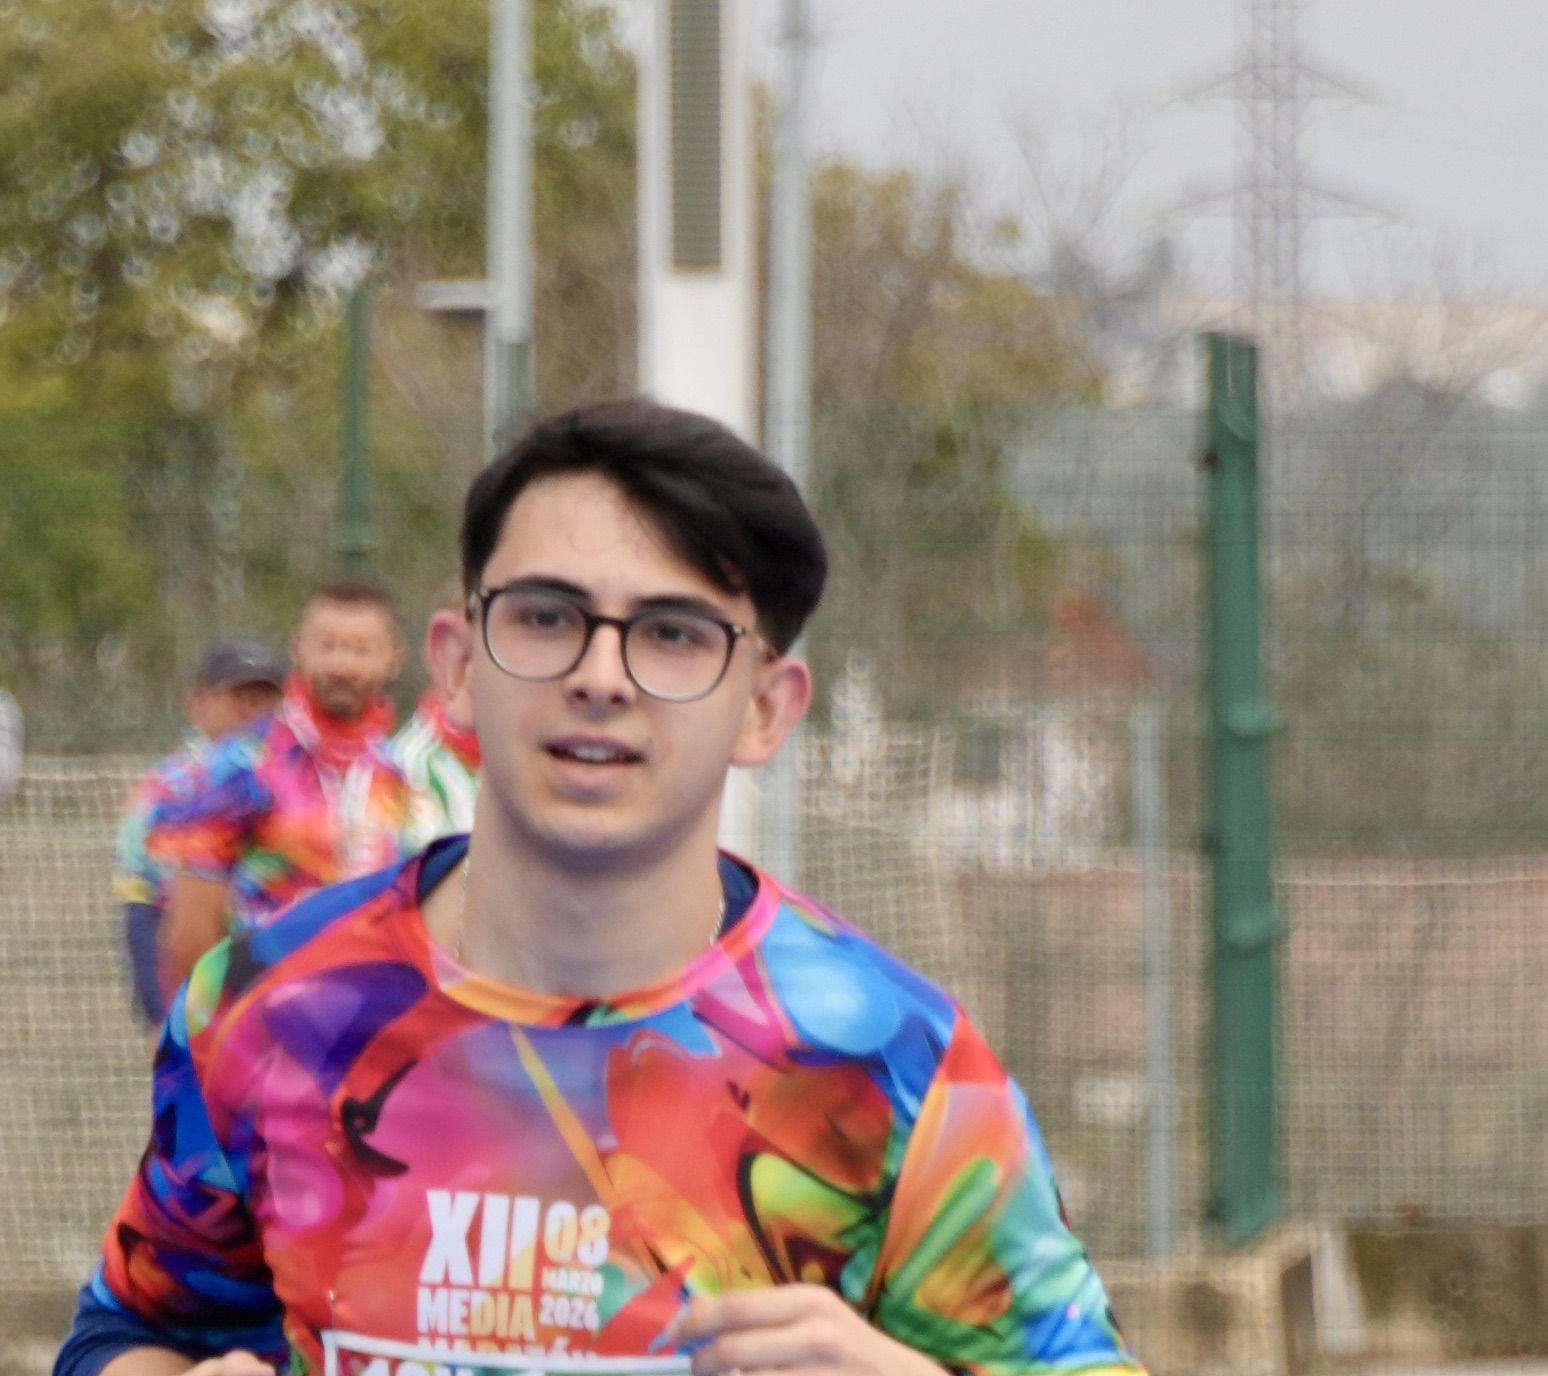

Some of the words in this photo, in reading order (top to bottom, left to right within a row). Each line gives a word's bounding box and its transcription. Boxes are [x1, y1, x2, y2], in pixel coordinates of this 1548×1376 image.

[418, 1189, 542, 1291] XII
[544, 1200, 611, 1268] 08
[416, 1287, 536, 1341] MEDIA
[539, 1293, 601, 1331] 2026
